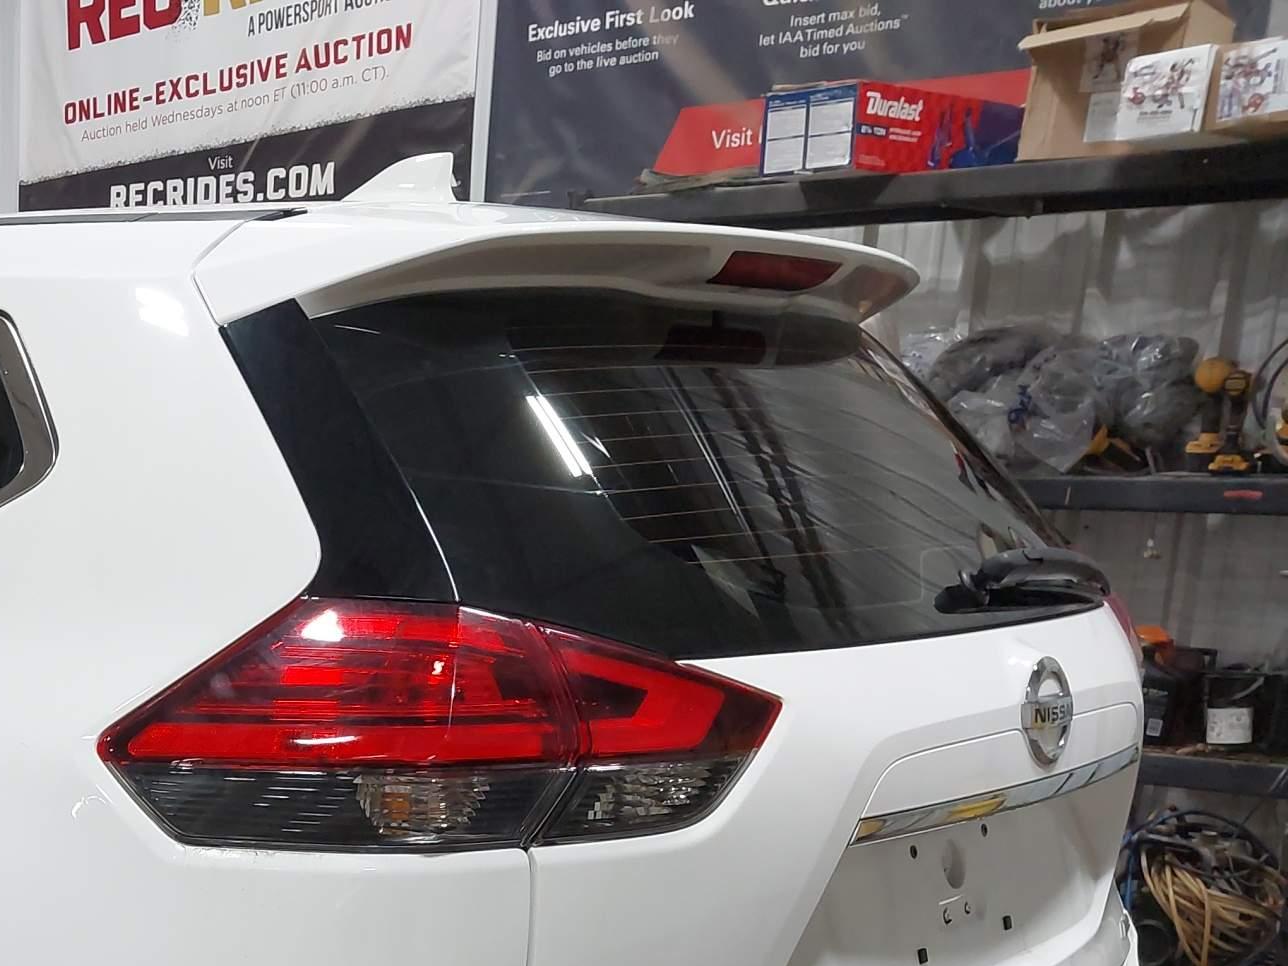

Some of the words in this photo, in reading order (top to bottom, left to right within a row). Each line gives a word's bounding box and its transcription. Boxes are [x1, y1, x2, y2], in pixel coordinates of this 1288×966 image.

[248, 15, 255, 37] A
[528, 15, 601, 42] Exclusive
[605, 9, 644, 30] First
[649, 0, 695, 24] Look
[790, 12, 826, 28] Insert
[828, 11, 856, 23] max
[859, 3, 881, 18] bid,
[537, 49, 552, 63] Bid
[553, 49, 567, 60] on
[569, 41, 613, 57] vehicles
[615, 35, 650, 51] before
[652, 33, 680, 46] they
[759, 34, 775, 47] let
[778, 29, 804, 44] IAA
[806, 26, 843, 41] Timed
[800, 45, 820, 58] bid
[822, 42, 840, 55] for
[843, 40, 866, 55] you
[64, 53, 288, 125] ONLINE-EXCLUSIVE
[294, 23, 412, 74] AUCTION
[548, 64, 562, 78] go
[564, 61, 575, 73] to
[576, 58, 594, 71] the
[596, 55, 617, 68] live
[619, 50, 659, 65] auction
[81, 124, 122, 142] Auction
[125, 117, 148, 133] held
[151, 102, 223, 128] Wednesdays
[227, 100, 238, 112] at
[241, 93, 270, 110] noon
[273, 86, 288, 103] ET
[290, 77, 328, 99] (11:00
[332, 74, 358, 89] a.m.
[361, 64, 390, 82] CT).
[866, 91, 924, 122] Duralast
[712, 128, 753, 150] Visit
[208, 154, 233, 171] Visit
[109, 161, 336, 208] RECRIDES.COM
